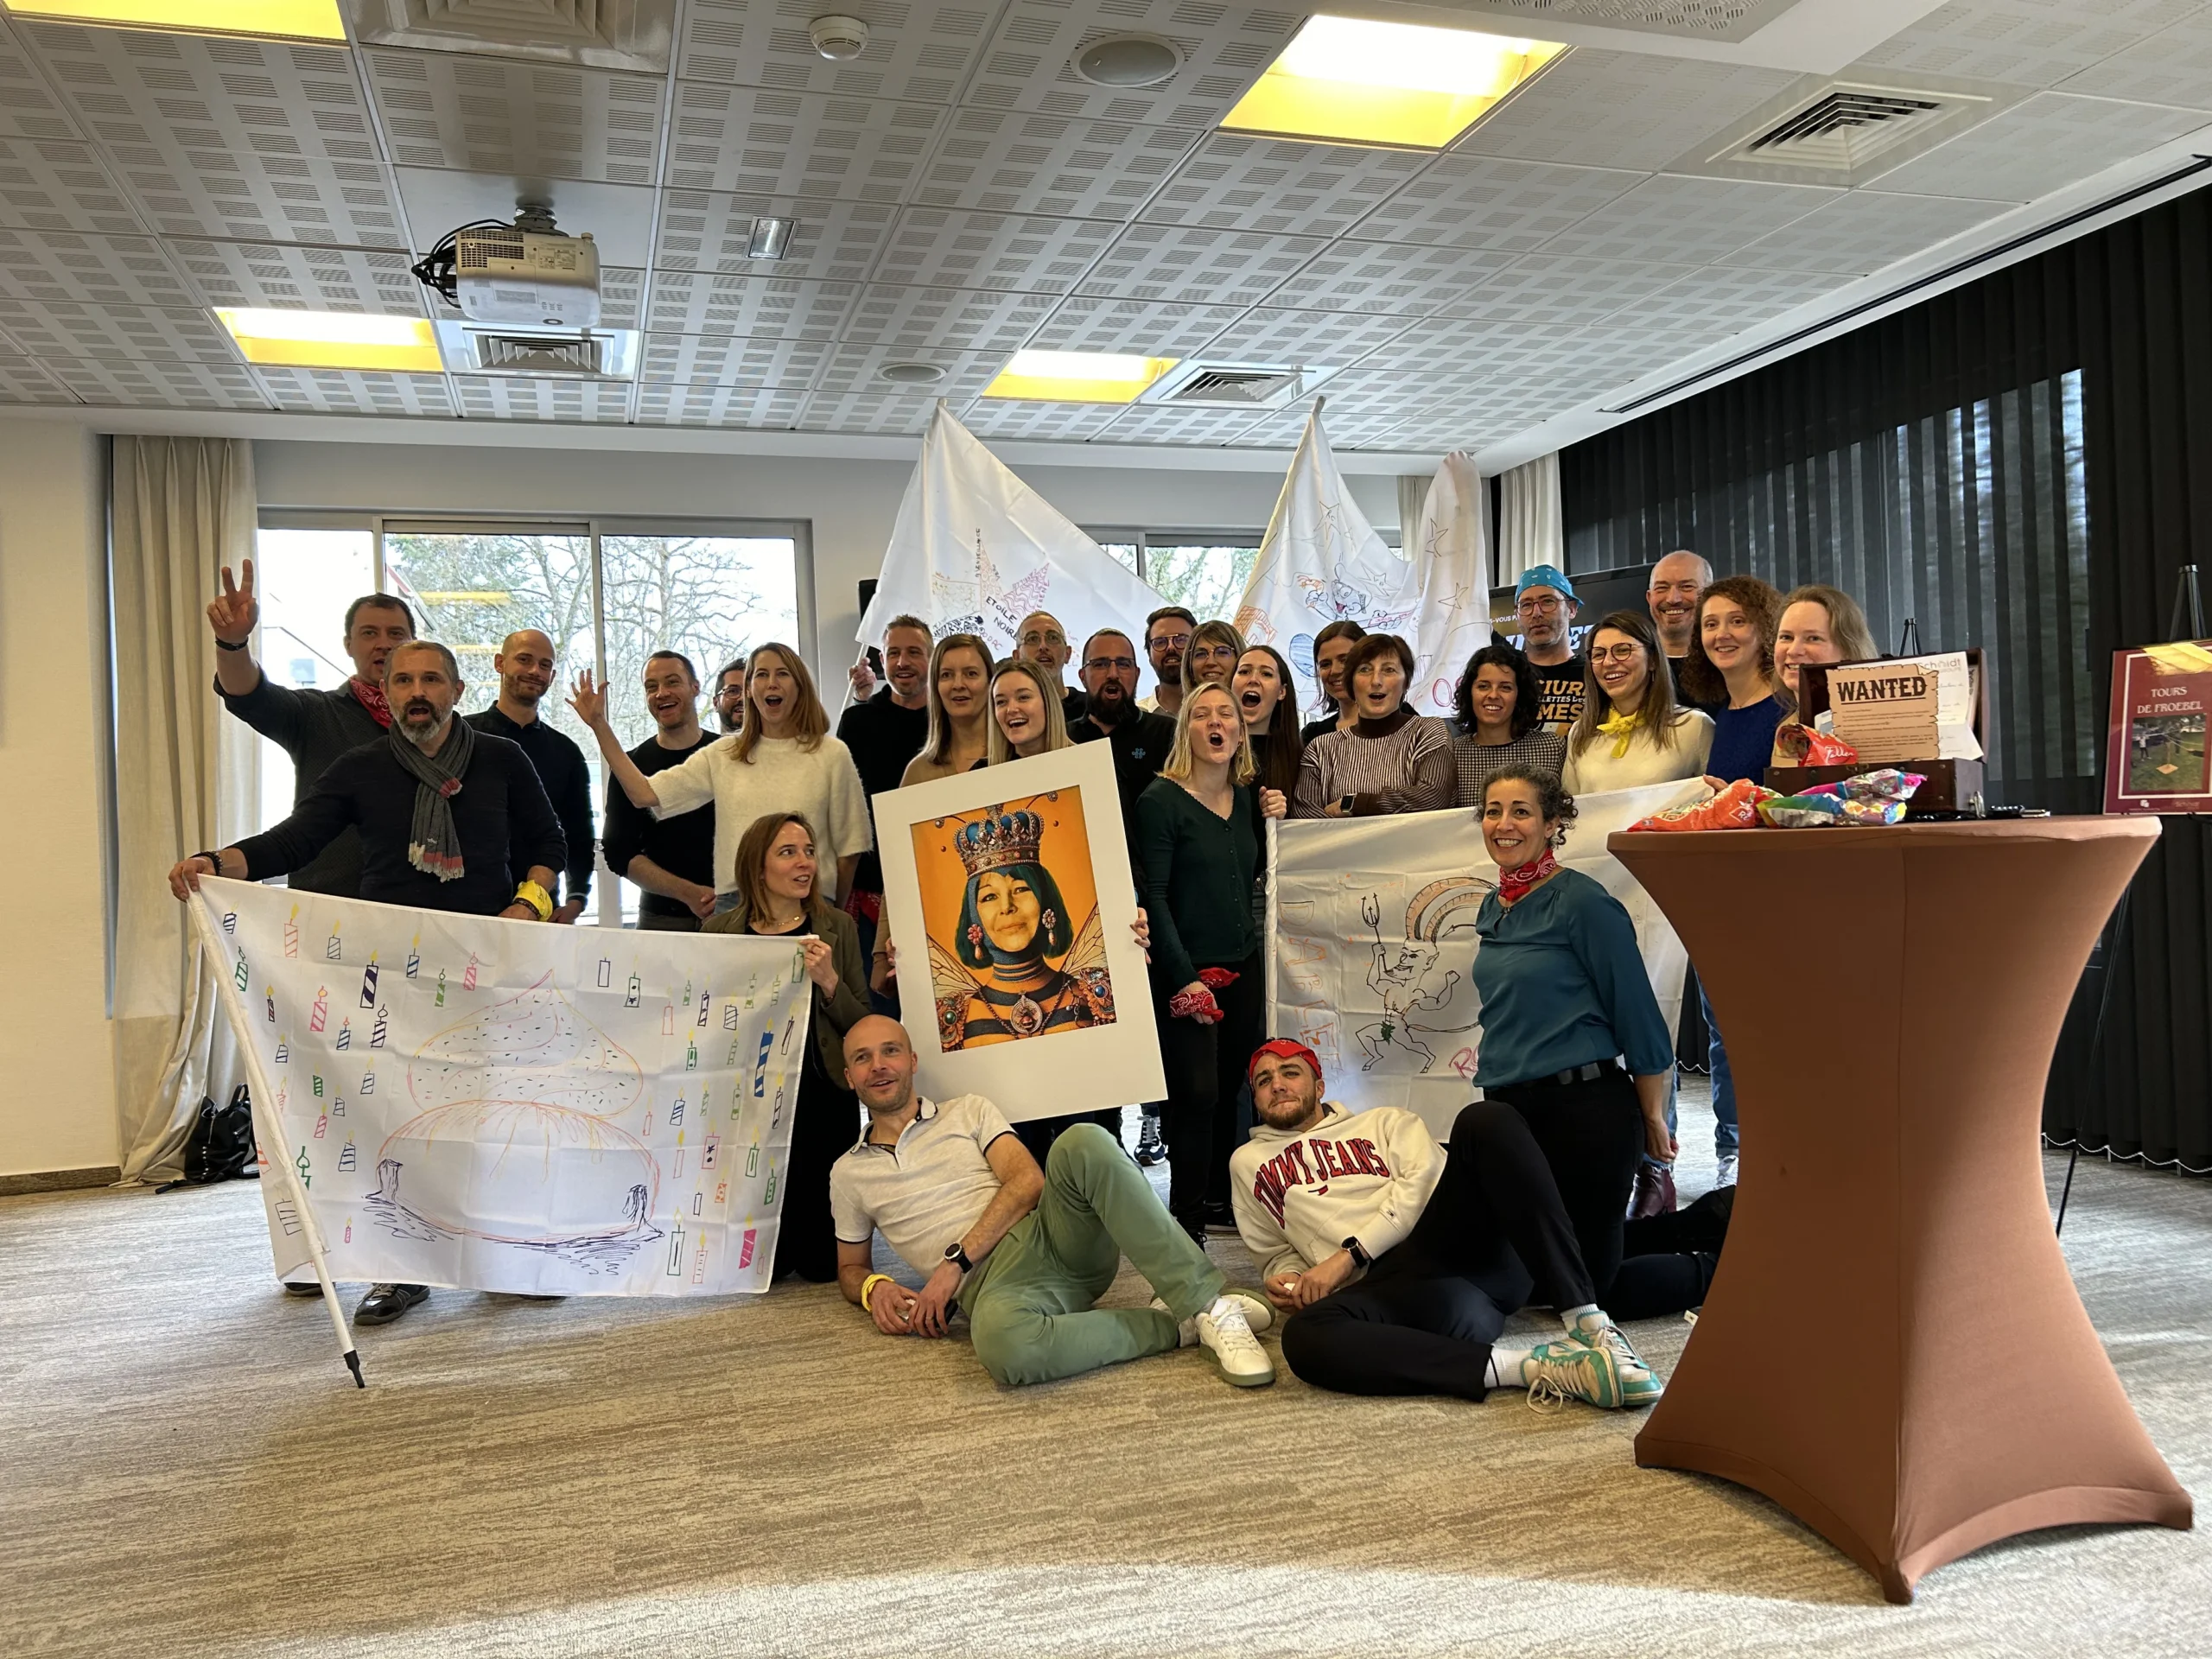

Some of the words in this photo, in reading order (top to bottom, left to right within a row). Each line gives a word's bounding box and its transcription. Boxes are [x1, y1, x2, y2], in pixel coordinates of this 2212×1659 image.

[1836, 676, 1929, 702] WANTED
[2151, 686, 2188, 698] TOURS
[2137, 704, 2152, 714] DE
[2154, 701, 2203, 714] FROEBEL
[1254, 1140, 1315, 1230] TOMMY
[1309, 1138, 1391, 1182] JEANS
